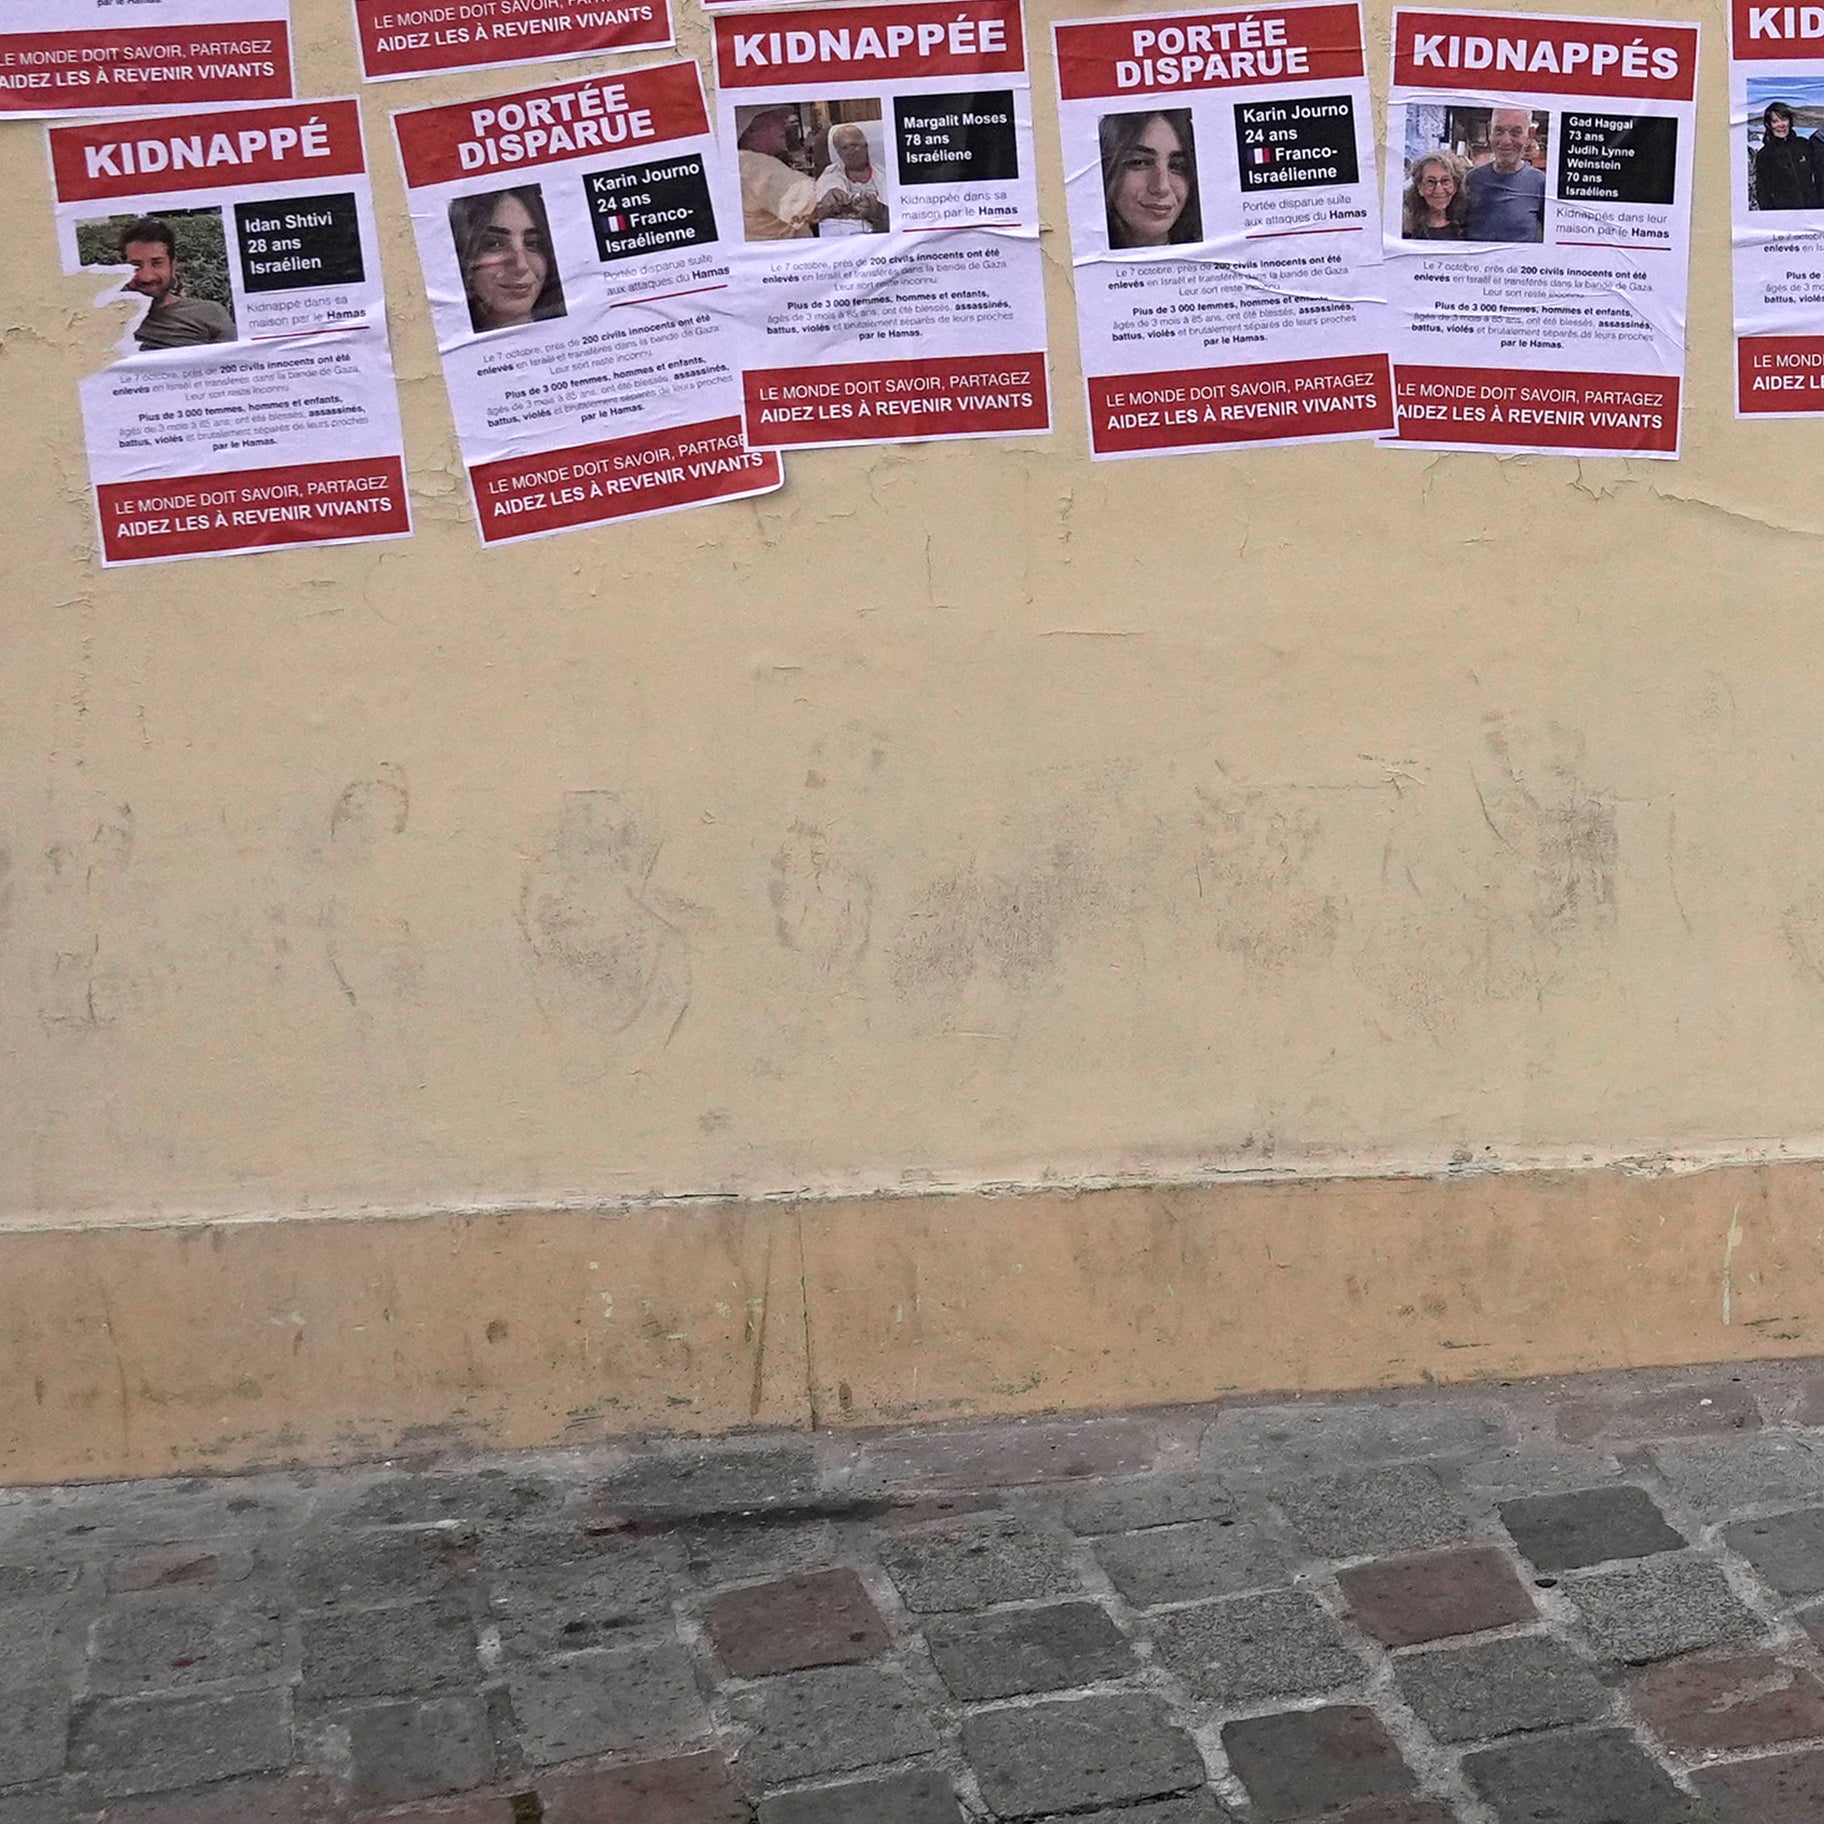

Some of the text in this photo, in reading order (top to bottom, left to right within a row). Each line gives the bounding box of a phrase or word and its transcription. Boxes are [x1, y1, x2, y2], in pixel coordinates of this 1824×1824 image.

[734, 14, 1006, 66] KIDNAPPÉE
[1133, 15, 1287, 56] PORTÉE
[1116, 47, 1309, 87] DISPARUE
[1414, 34, 1678, 79] KIDNAPPÉS
[471, 83, 629, 142] PORTÉE
[904, 113, 1007, 130] Margalit Moses
[85, 117, 330, 178] KIDNAPPÉ
[458, 104, 655, 169] DISPARUE
[905, 134, 949, 146] 78 ans
[245, 212, 332, 232] Idan Shtivi
[248, 239, 301, 253] 28 ans
[250, 257, 321, 274] Israélien
[1754, 355, 1771, 367] LE
[1753, 376, 1805, 390] AIDEZ
